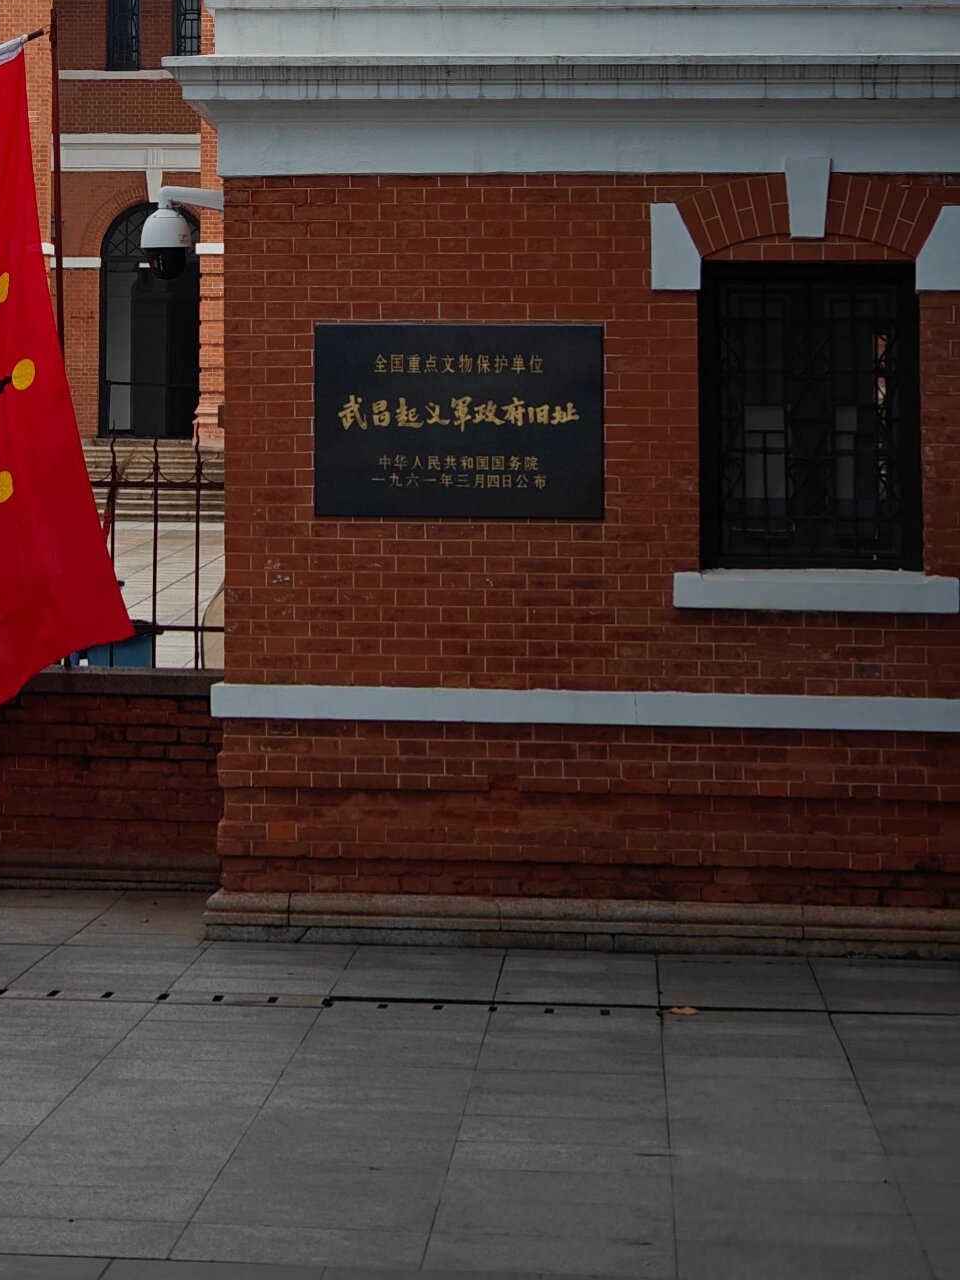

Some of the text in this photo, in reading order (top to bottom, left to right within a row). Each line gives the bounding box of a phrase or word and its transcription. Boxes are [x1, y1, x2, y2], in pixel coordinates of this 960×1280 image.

[374, 354, 544, 374] 全国重点文物保护单位
[379, 455, 539, 471] 中华人民共和国国务院
[371, 473, 547, 490] 一九六一年三月四日公布
